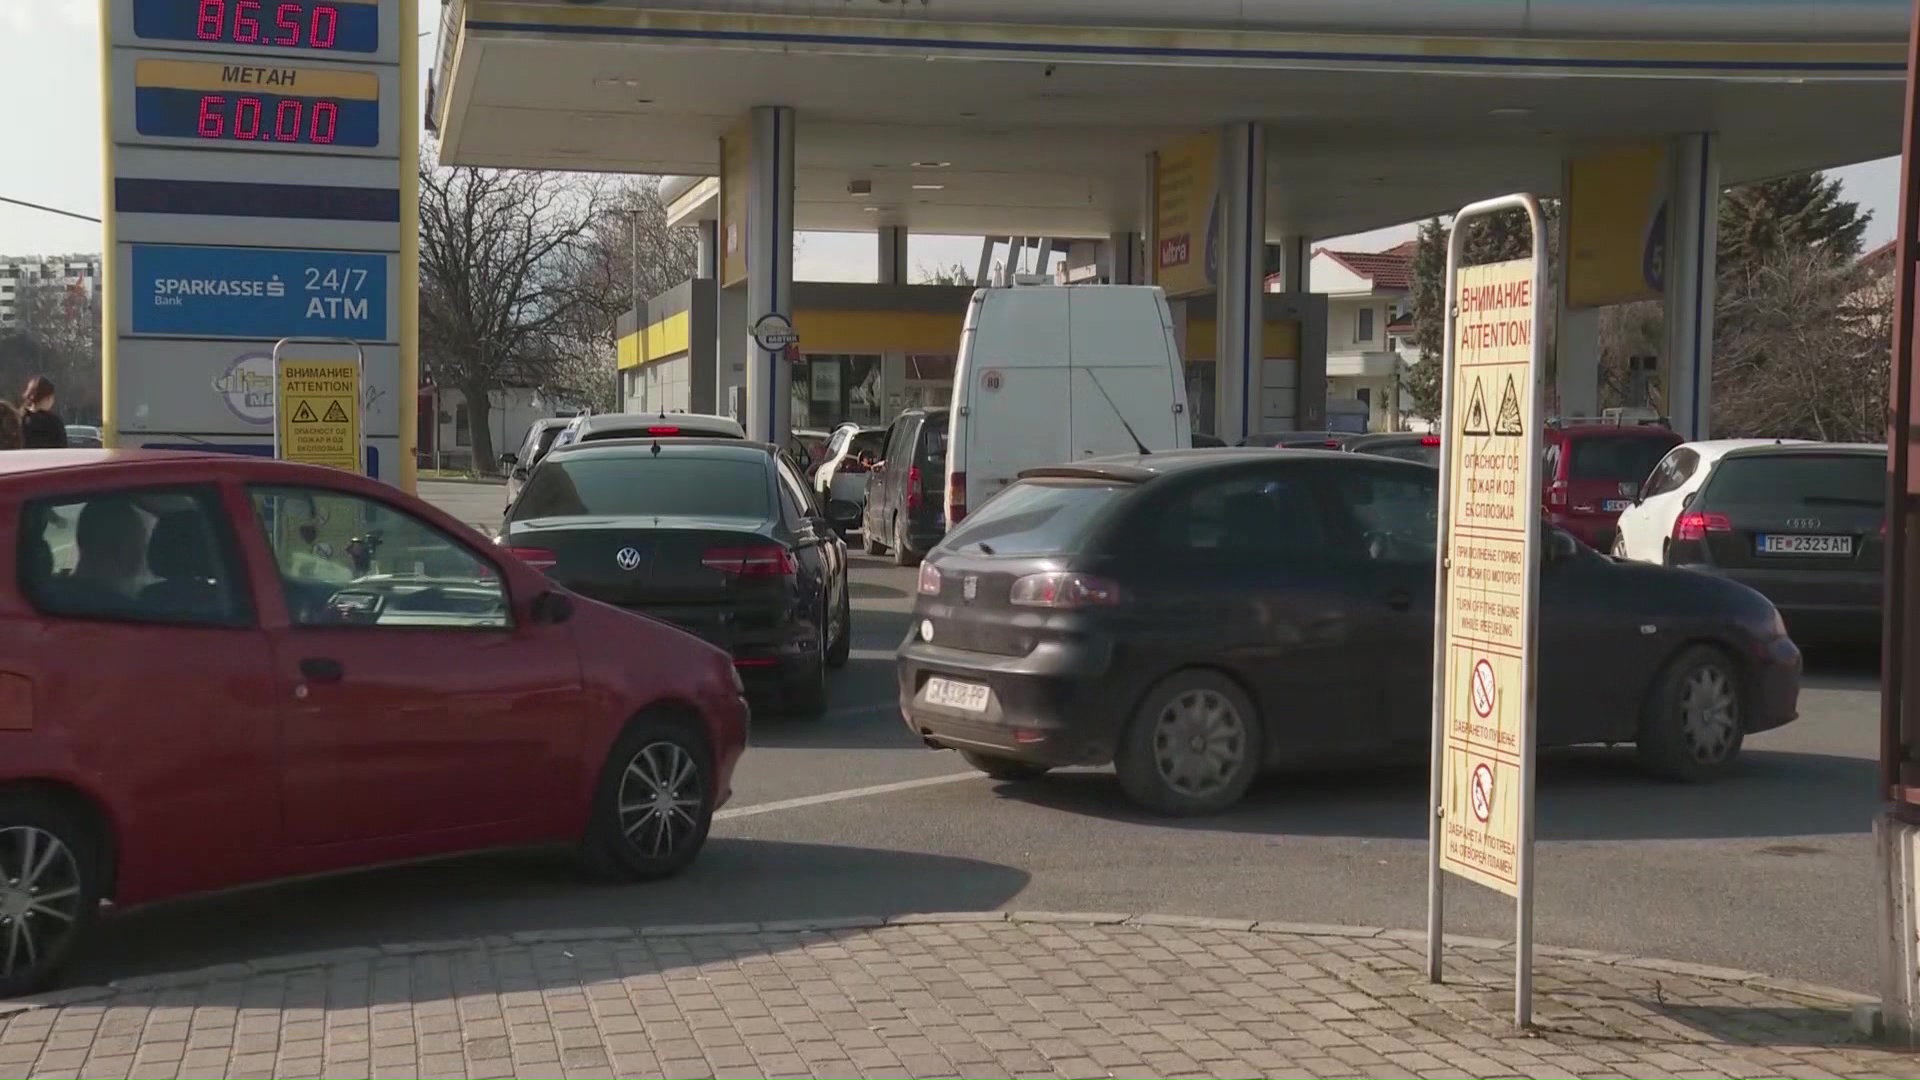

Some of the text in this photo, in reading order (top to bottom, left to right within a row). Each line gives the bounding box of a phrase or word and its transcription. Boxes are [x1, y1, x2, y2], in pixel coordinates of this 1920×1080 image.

[197, 0, 338, 48] 86.50
[222, 66, 296, 86] МЕТАН
[198, 95, 338, 144] 60.00
[154, 279, 264, 297] SPARKASSE
[304, 267, 369, 294] 24/7
[154, 296, 182, 305] Bank
[1462, 279, 1532, 312] ВНИМАНИЕ!
[305, 297, 368, 320] ATM
[1462, 320, 1532, 349] ATTENTION!
[286, 367, 353, 379] ВНИМАНИЕ!
[286, 381, 353, 392] ATTENTION!
[1464, 453, 1519, 474] ОПАСНОСТ ОД
[1466, 478, 1515, 500] ПОЖАР И ОД
[1465, 501, 1515, 520] ЕКСПЛОЗИЈА
[1767, 536, 1849, 551] TE 2323 AM
[1456, 597, 1520, 620] TURN OFF THE ENGINE
[1450, 840, 1459, 854] НА
